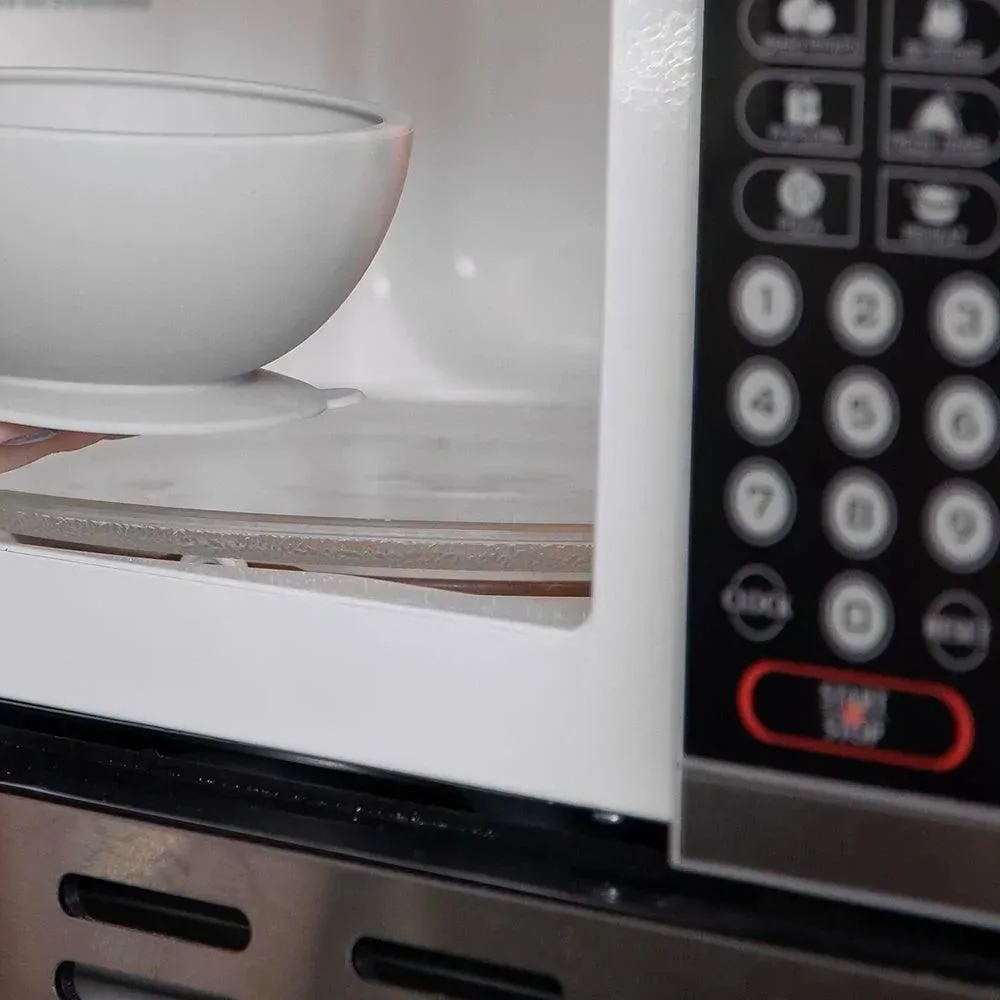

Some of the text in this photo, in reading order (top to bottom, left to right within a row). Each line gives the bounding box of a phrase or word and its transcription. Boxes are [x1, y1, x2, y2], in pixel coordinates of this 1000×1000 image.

[759, 284, 774, 317] 1
[752, 386, 776, 416] 4
[750, 485, 775, 519] 7
